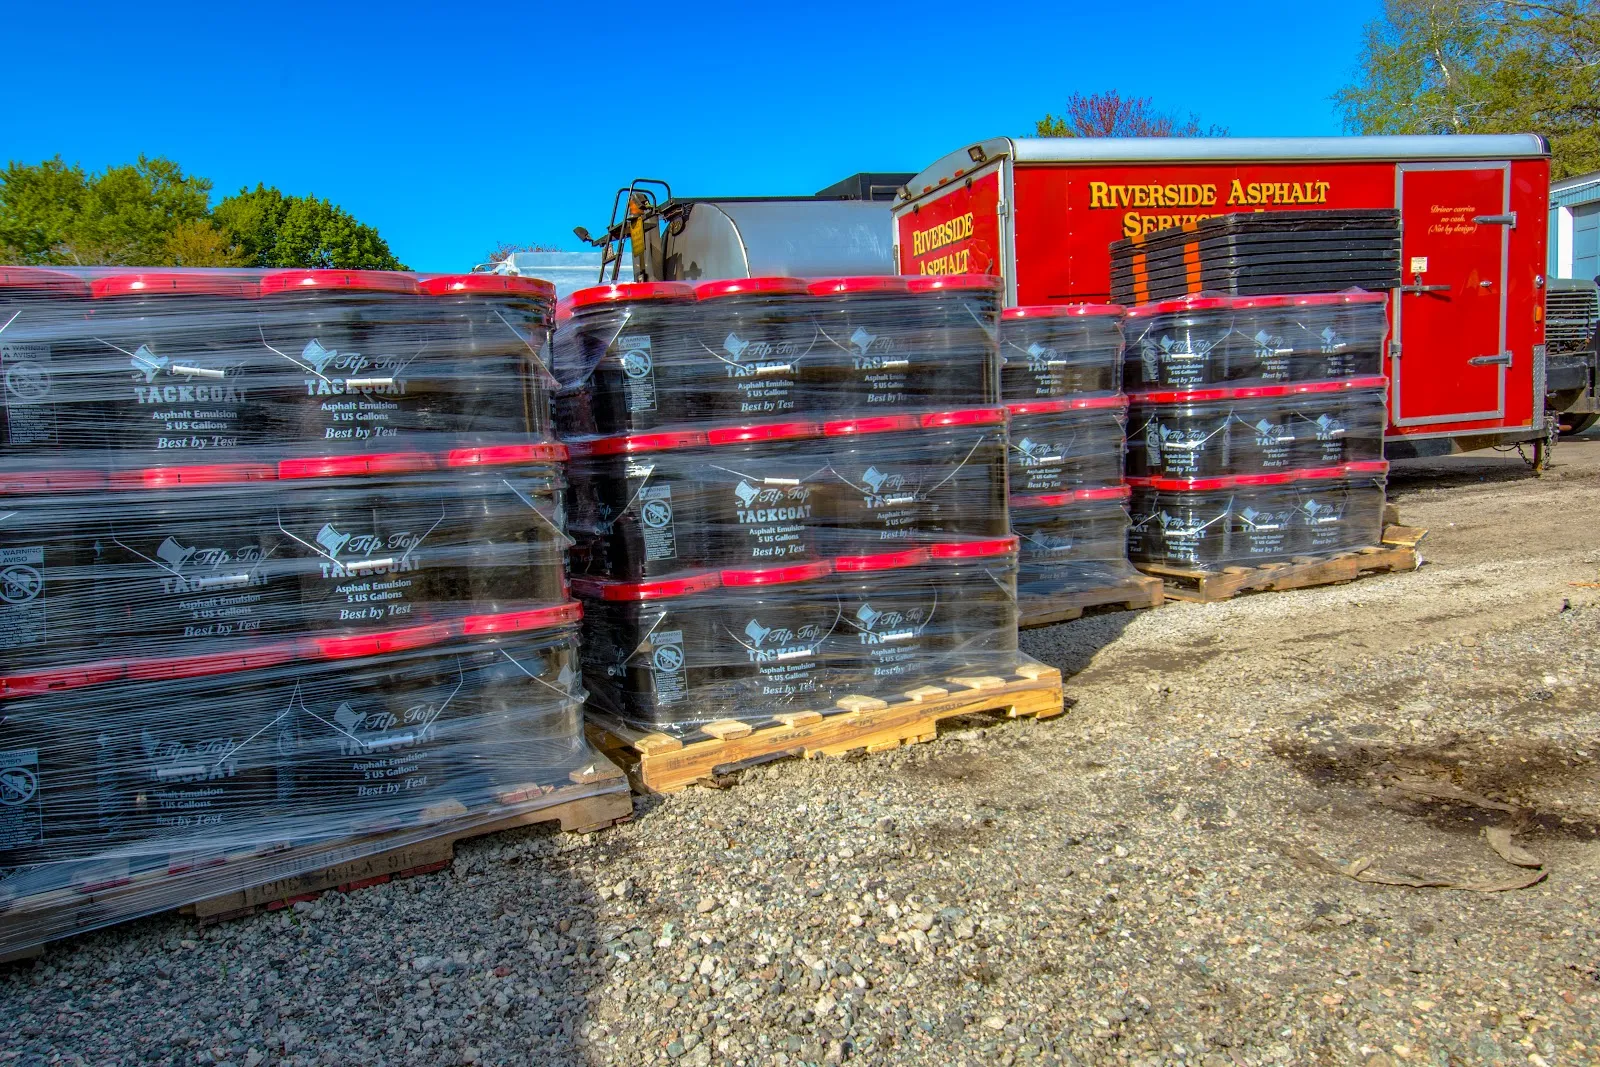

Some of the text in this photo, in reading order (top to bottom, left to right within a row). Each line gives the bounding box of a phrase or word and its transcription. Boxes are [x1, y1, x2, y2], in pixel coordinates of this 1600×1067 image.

[1089, 180, 1330, 208] RIVERSIDE ASPHALT
[1431, 205, 1453, 213] Driver
[1123, 212, 1225, 237] SERV
[1428, 224, 1478, 236] (Not by design)
[913, 212, 974, 257] RIVERSIDE
[920, 249, 970, 276] ASPHALT
[748, 342, 799, 359] Tip Top
[1194, 340, 1211, 351] Top
[335, 353, 408, 378] Tip Top
[865, 374, 889, 382] Asphalt
[738, 381, 764, 390] Asphalt
[135, 386, 248, 404] TACKCOAT
[867, 393, 896, 402] Best by
[321, 402, 398, 412] Asphalt Emulsion
[741, 400, 794, 412] Best by Test
[153, 410, 237, 420] Asphalt Emulsion
[333, 412, 388, 421] 5 US Gallons
[166, 421, 227, 430] 5 US Gallons
[325, 427, 397, 440] Best by Test
[1169, 430, 1206, 443] Tip Top
[157, 436, 237, 449] Best by Test
[1036, 444, 1051, 455] Tip
[759, 486, 810, 507] Tip Top
[737, 505, 811, 523] TACKCOAT
[1170, 518, 1185, 529] Tip
[750, 525, 805, 536] Asphalt Emulsion
[881, 531, 898, 540] Best
[349, 532, 421, 557] Tip Top
[752, 544, 805, 557] Best by Test
[3, 548, 42, 556] WARNING
[194, 545, 269, 571] Tip Top
[160, 570, 269, 594] TACAT
[336, 580, 412, 594] Asphalt Emulsion
[179, 597, 218, 610] Asphalt
[348, 595, 353, 603] 5
[370, 591, 403, 601] Gallons
[340, 604, 412, 620] Best by Test
[880, 607, 924, 629] Tip Top
[184, 621, 260, 637] Best by Test
[769, 625, 820, 646] Tip Top
[871, 648, 896, 656] Asphalt
[787, 662, 816, 671] Emulsion
[874, 666, 905, 675] Best by
[785, 672, 809, 680] Gallons
[763, 686, 783, 695] Best
[785, 685, 796, 693] by
[365, 704, 436, 734] Tip Top
[196, 738, 236, 760] Top
[353, 752, 428, 771] Asphalt Emulsion
[372, 770, 384, 778] US
[386, 764, 419, 776] Gallons
[358, 776, 427, 796] Best by Test
[178, 800, 212, 809] Gallons
[177, 813, 223, 828] by Test
